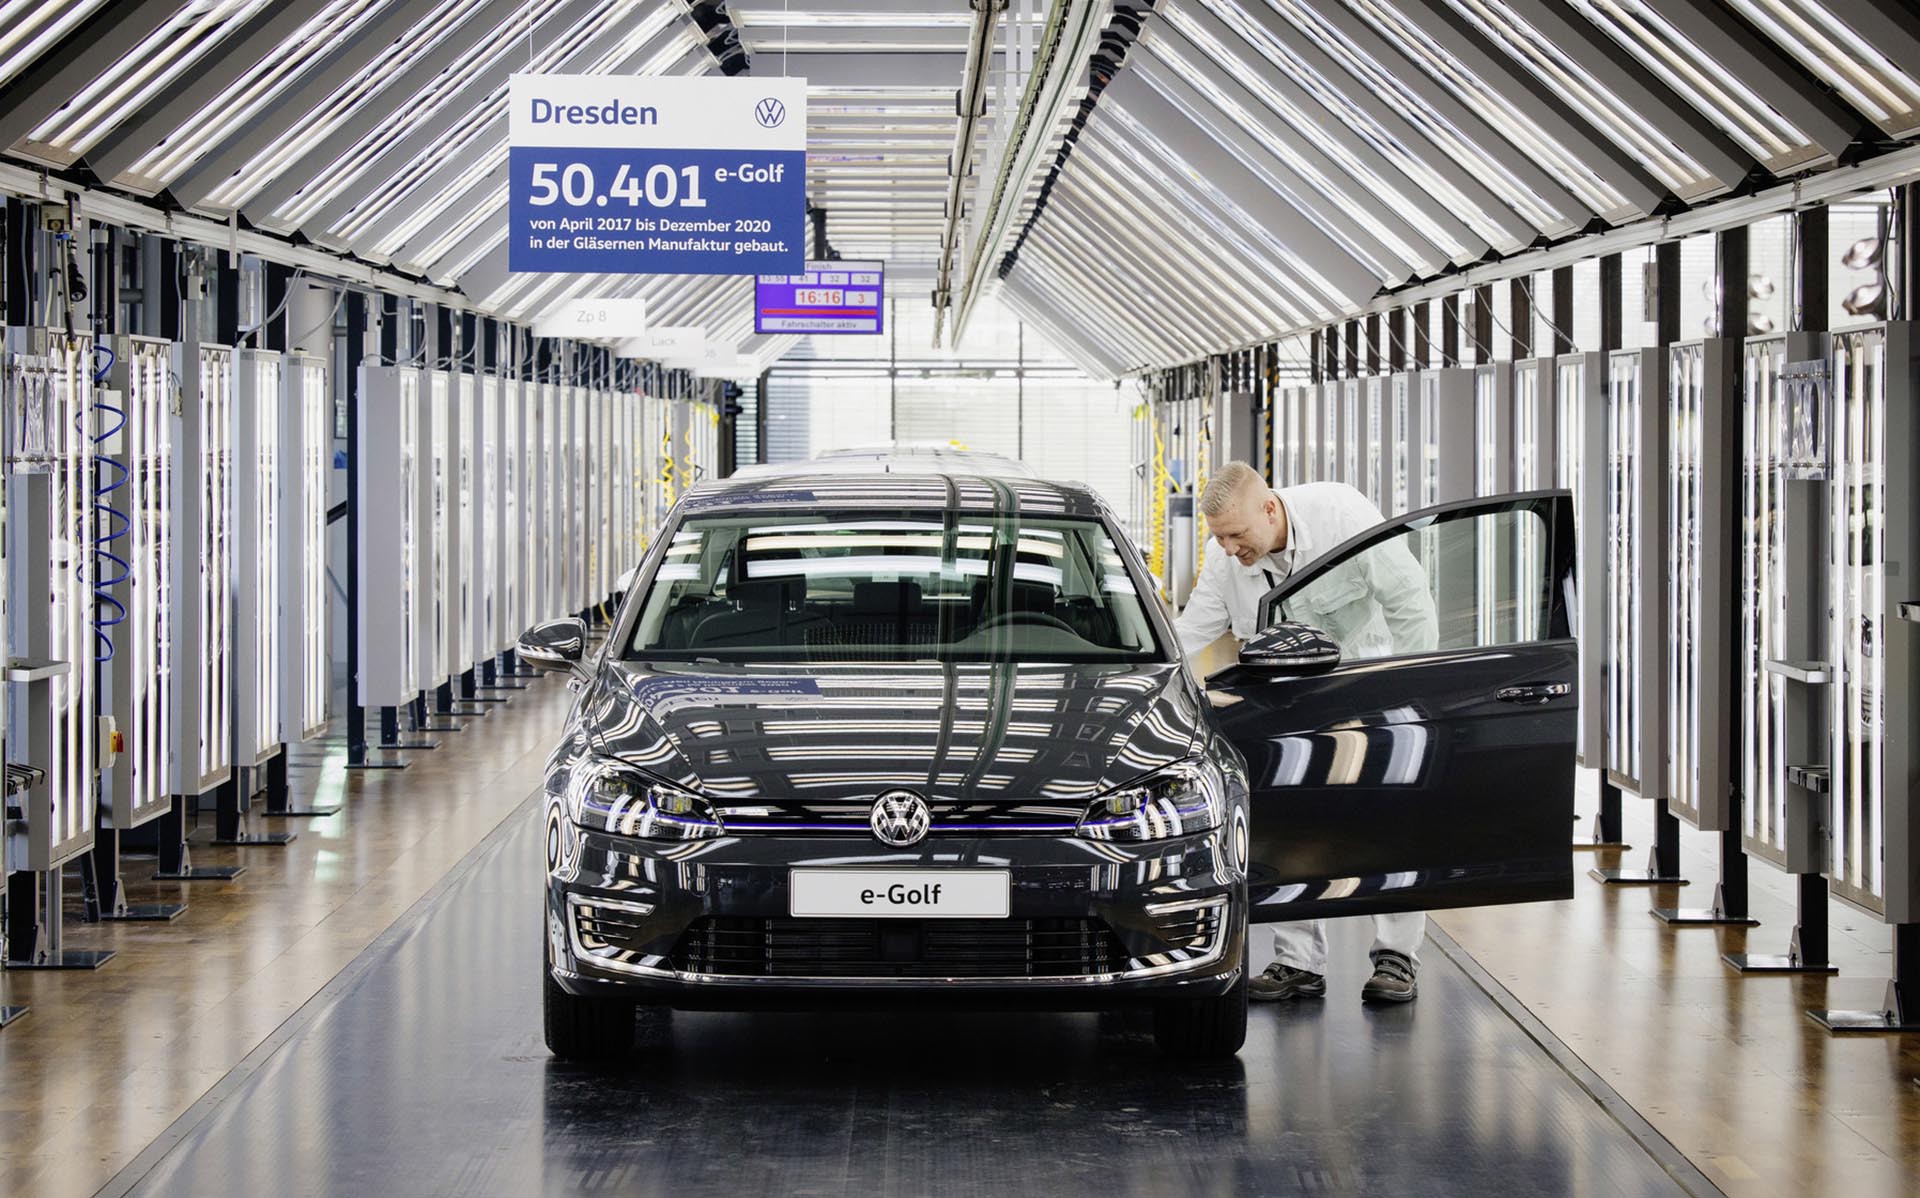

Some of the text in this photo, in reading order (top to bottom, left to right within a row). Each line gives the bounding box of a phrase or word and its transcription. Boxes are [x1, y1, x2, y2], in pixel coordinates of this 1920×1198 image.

[532, 98, 658, 125] Dresden
[529, 162, 785, 208] 50.401 e-Golf
[529, 217, 771, 233] von April 2017 bis Dezember 2020
[529, 235, 789, 255] in der Gläsernen Manufaktur gebaut.
[799, 290, 865, 304] 16:16 3
[576, 310, 607, 323] Zp 8
[836, 320, 857, 329] aktiv
[860, 883, 942, 905] e-Golf
